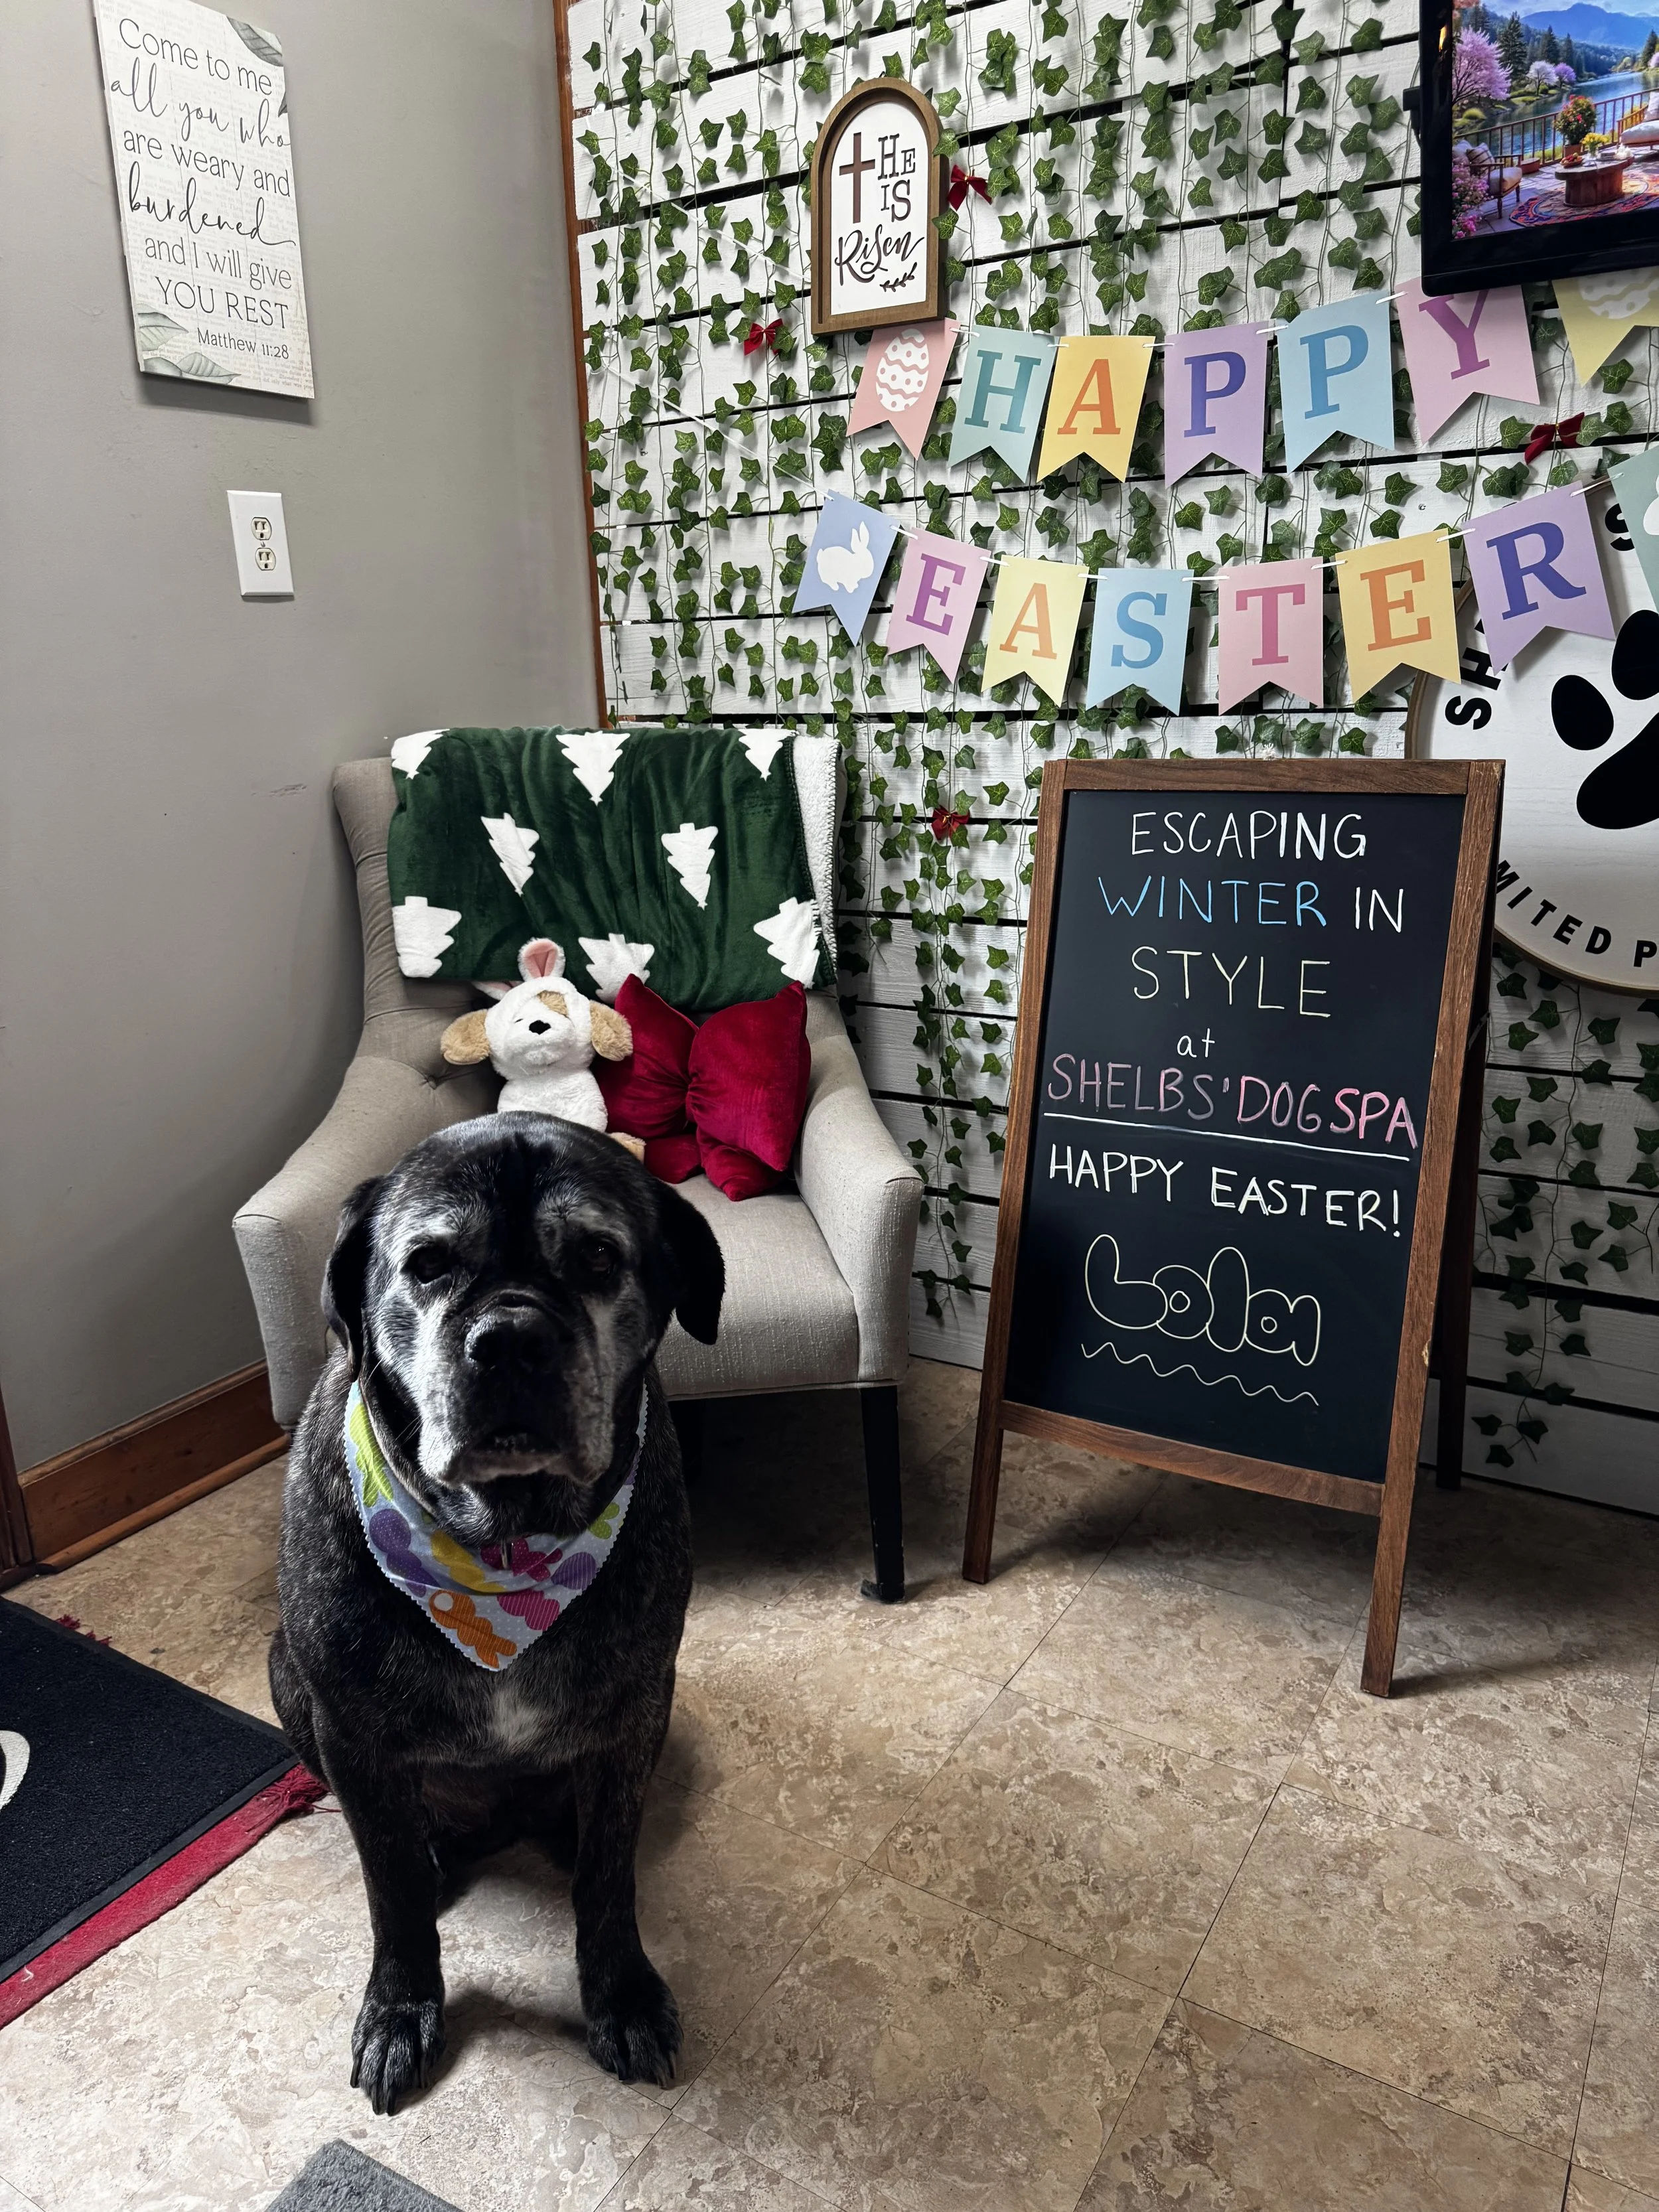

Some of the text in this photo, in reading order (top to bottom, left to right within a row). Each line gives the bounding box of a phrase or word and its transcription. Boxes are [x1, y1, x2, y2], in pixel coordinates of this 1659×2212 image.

[119, 18, 272, 96] Come to me
[110, 56, 291, 147] all you who
[123, 129, 291, 197] are weary and
[129, 161, 296, 246] burdened
[880, 179, 911, 223] IS
[145, 236, 292, 291] and I will give
[834, 223, 926, 287] Risen
[155, 275, 289, 329] YOU REST
[197, 327, 257, 354] Matthew
[261, 343, 289, 360] 11:28
[964, 290, 1490, 437] HAPPY
[905, 522, 1587, 670] EASTER
[1131, 810, 1367, 861] ESCAPING
[1098, 874, 1405, 933] WINTER IN
[1496, 859, 1612, 955] MITED
[1131, 945, 1332, 1018] STYLE
[1176, 1027, 1216, 1059] at
[1048, 1143, 1401, 1239] HAPPY EASTER!
